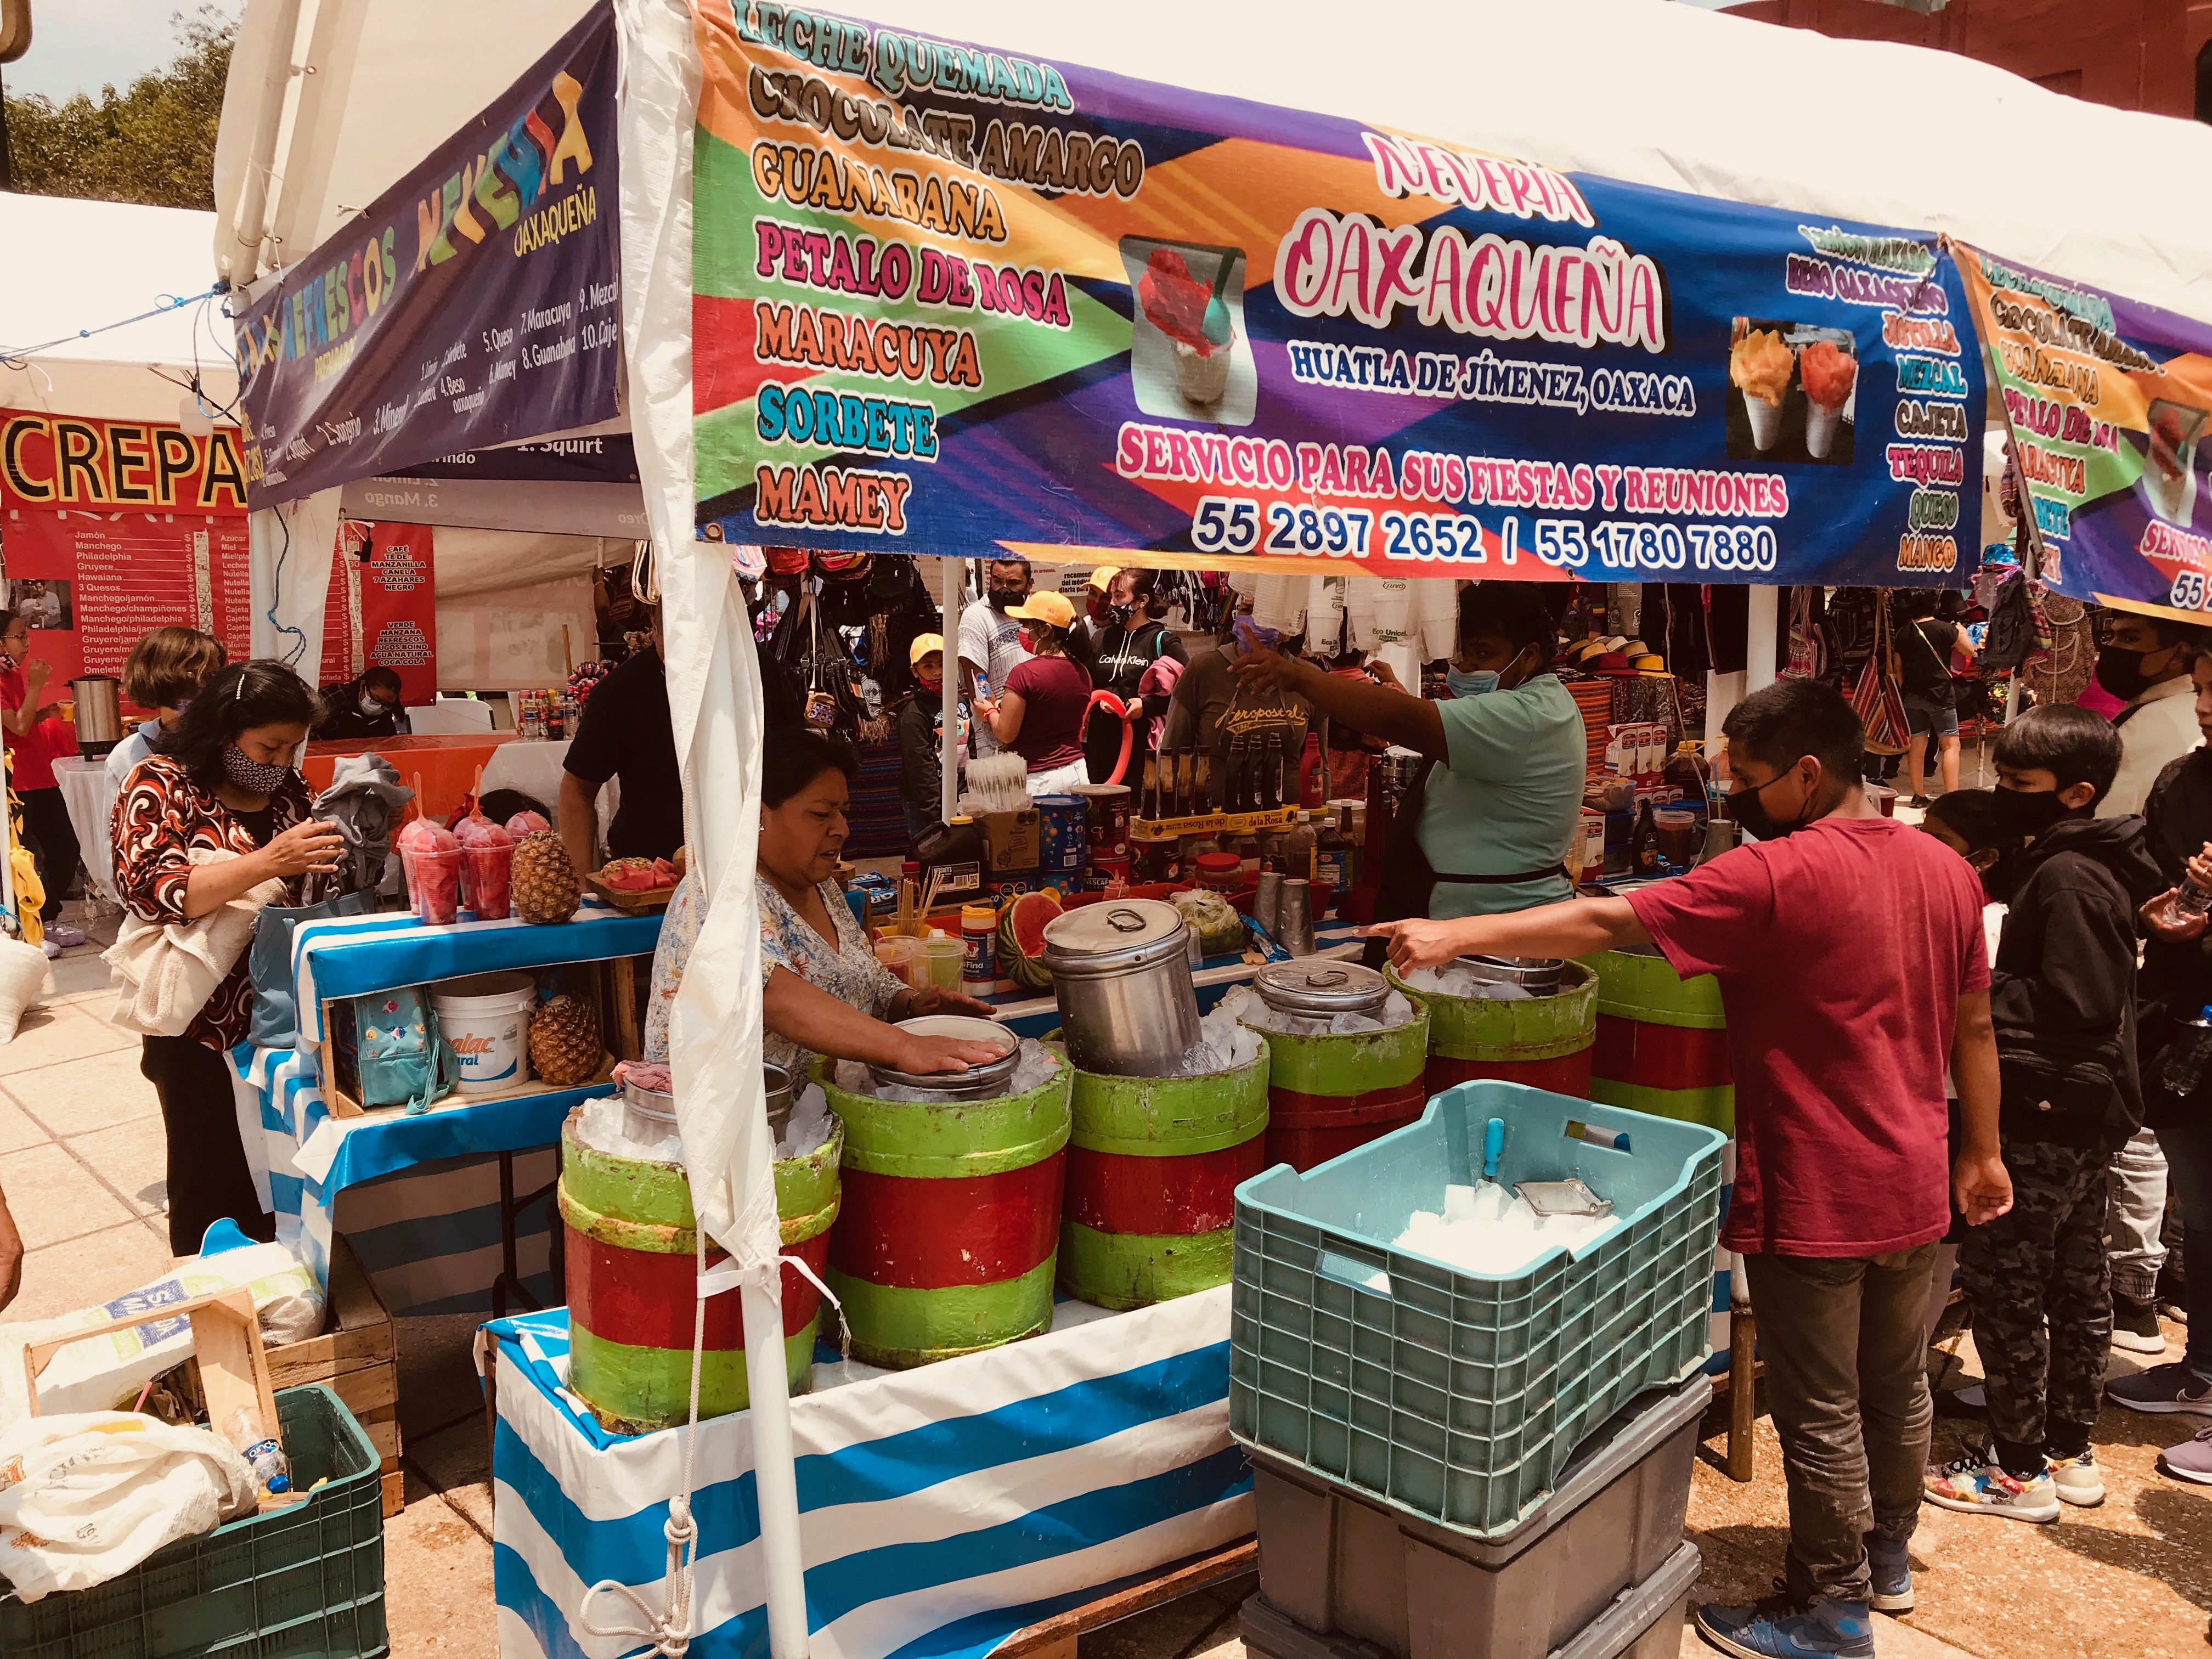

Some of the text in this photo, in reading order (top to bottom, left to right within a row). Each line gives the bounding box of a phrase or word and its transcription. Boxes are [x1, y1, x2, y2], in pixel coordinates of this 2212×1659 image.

[733, 0, 1073, 112] LECHE QUEMADA
[749, 66, 1144, 198] CHOCOLATE AMARGO
[753, 144, 1008, 244] GUANABANA
[514, 183, 596, 257] OAXAQUEÑA
[281, 226, 396, 361] REFRESCOS
[755, 222, 1071, 329] PETALO DE ROSA
[1281, 213, 1661, 348] OAXAQUEÑA
[755, 302, 983, 388] MARACUYA
[1291, 344, 1413, 392] HUATLA
[1417, 356, 1459, 393] DE
[1593, 370, 1695, 414] OAXACA
[1897, 356, 1967, 396] MEZCAL
[756, 384, 938, 460] SORBETE
[1897, 400, 1967, 440] CAJETA
[1117, 424, 1789, 517] SERVICIO PARA SUS FIESTAS Y REUNIONES
[1887, 445, 1964, 490] TEQUILA
[755, 465, 910, 533] MAMEY
[1910, 491, 1959, 533] QUESO
[75, 531, 105, 539] Jamón
[75, 542, 122, 551] Manchego
[1194, 498, 1258, 550] 55
[1269, 504, 1372, 556] 2897
[1383, 513, 1486, 562] 2652
[1537, 519, 1587, 567] 55
[1593, 522, 1685, 569] 1780
[1688, 524, 1777, 571] 7880
[1898, 535, 1957, 572] MANGO
[76, 552, 132, 561] Philadelphia
[77, 563, 114, 572] Gruyere
[78, 573, 122, 582] Hawaiana
[86, 584, 121, 592] Quesos
[2170, 570, 2205, 608] 55
[79, 594, 155, 603] Manchego/jamón
[80, 604, 187, 614] Manchego/champiñones
[200, 604, 213, 613] 50
[225, 606, 249, 614] Cajeta
[81, 614, 183, 624] Manchego/philadelphia
[1099, 654, 1149, 667] Calvin Klein
[1264, 814, 1283, 825] Rosa
[1085, 877, 1110, 885] NESCAF
